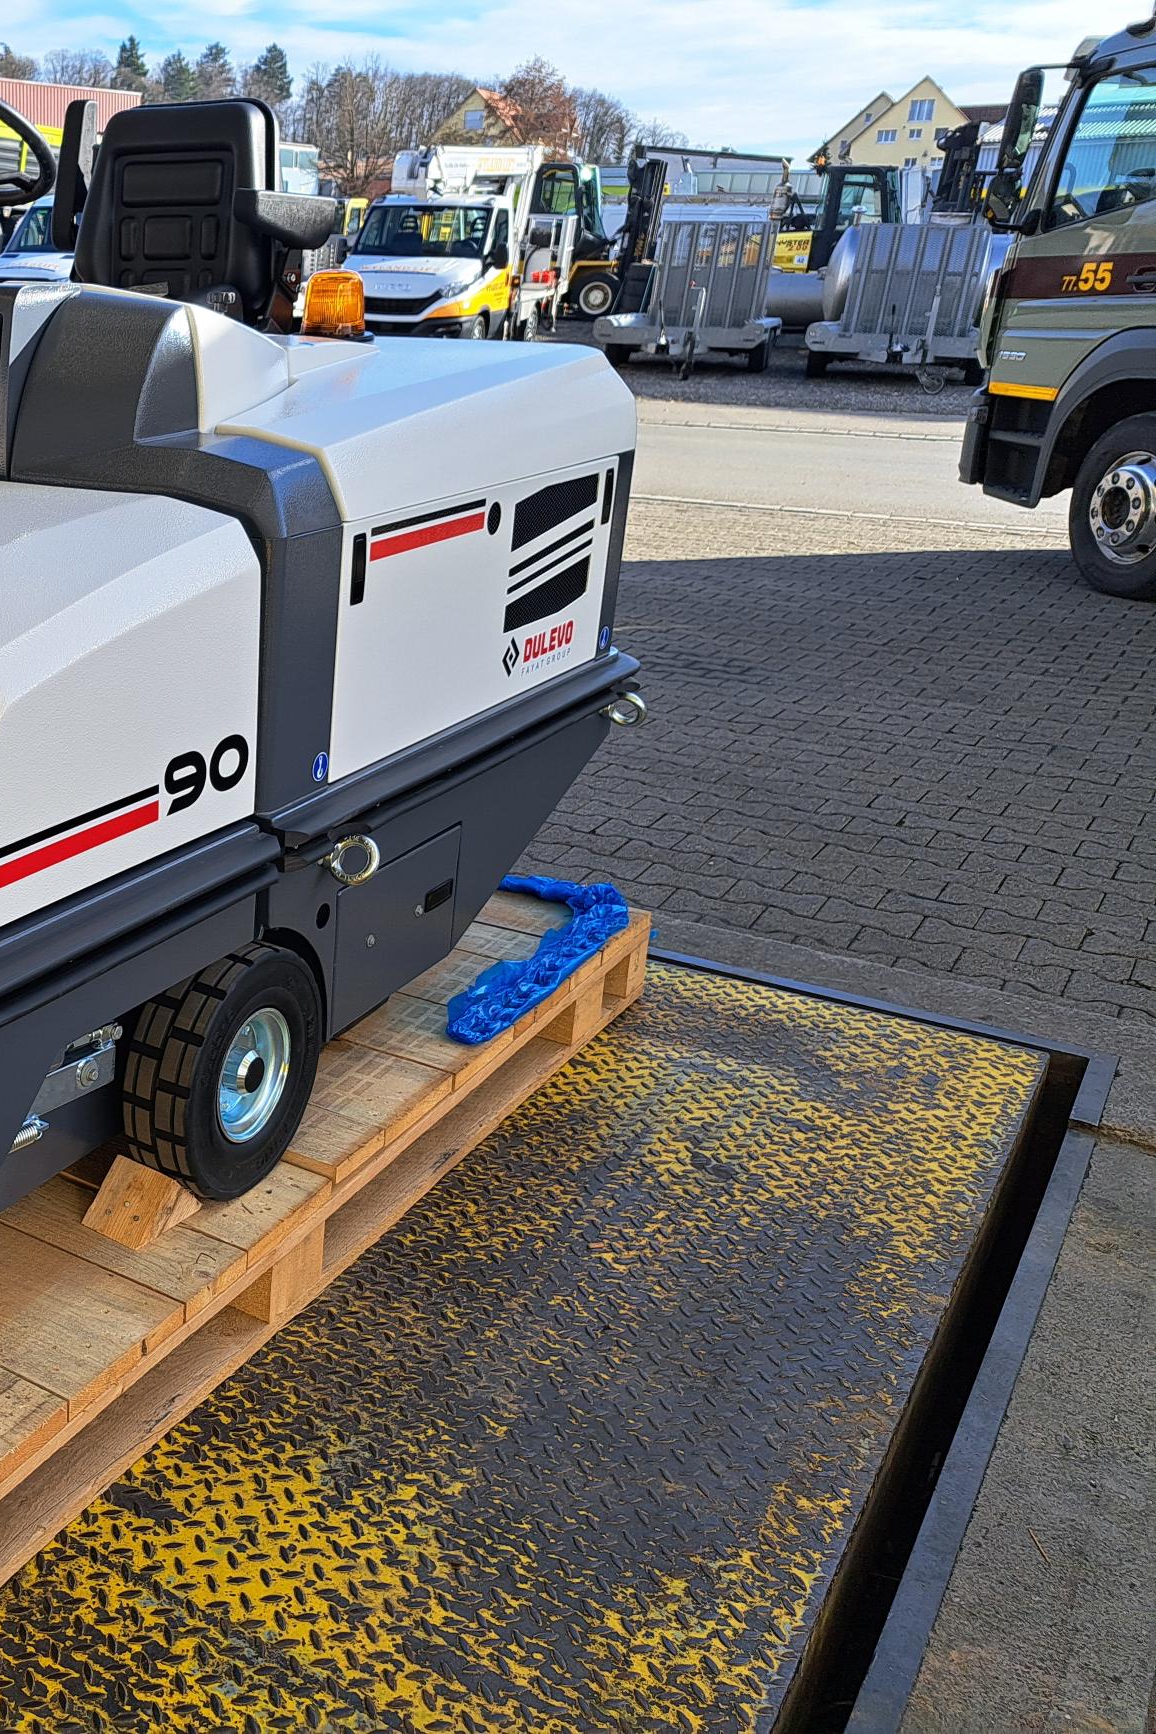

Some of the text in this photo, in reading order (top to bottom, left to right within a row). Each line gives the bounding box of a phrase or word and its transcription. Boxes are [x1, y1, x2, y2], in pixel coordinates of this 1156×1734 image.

[1062, 262, 1114, 291] 77.55
[523, 620, 574, 663] DULEVO
[521, 647, 572, 676] FAYAT GROUP
[164, 734, 249, 816] 90
